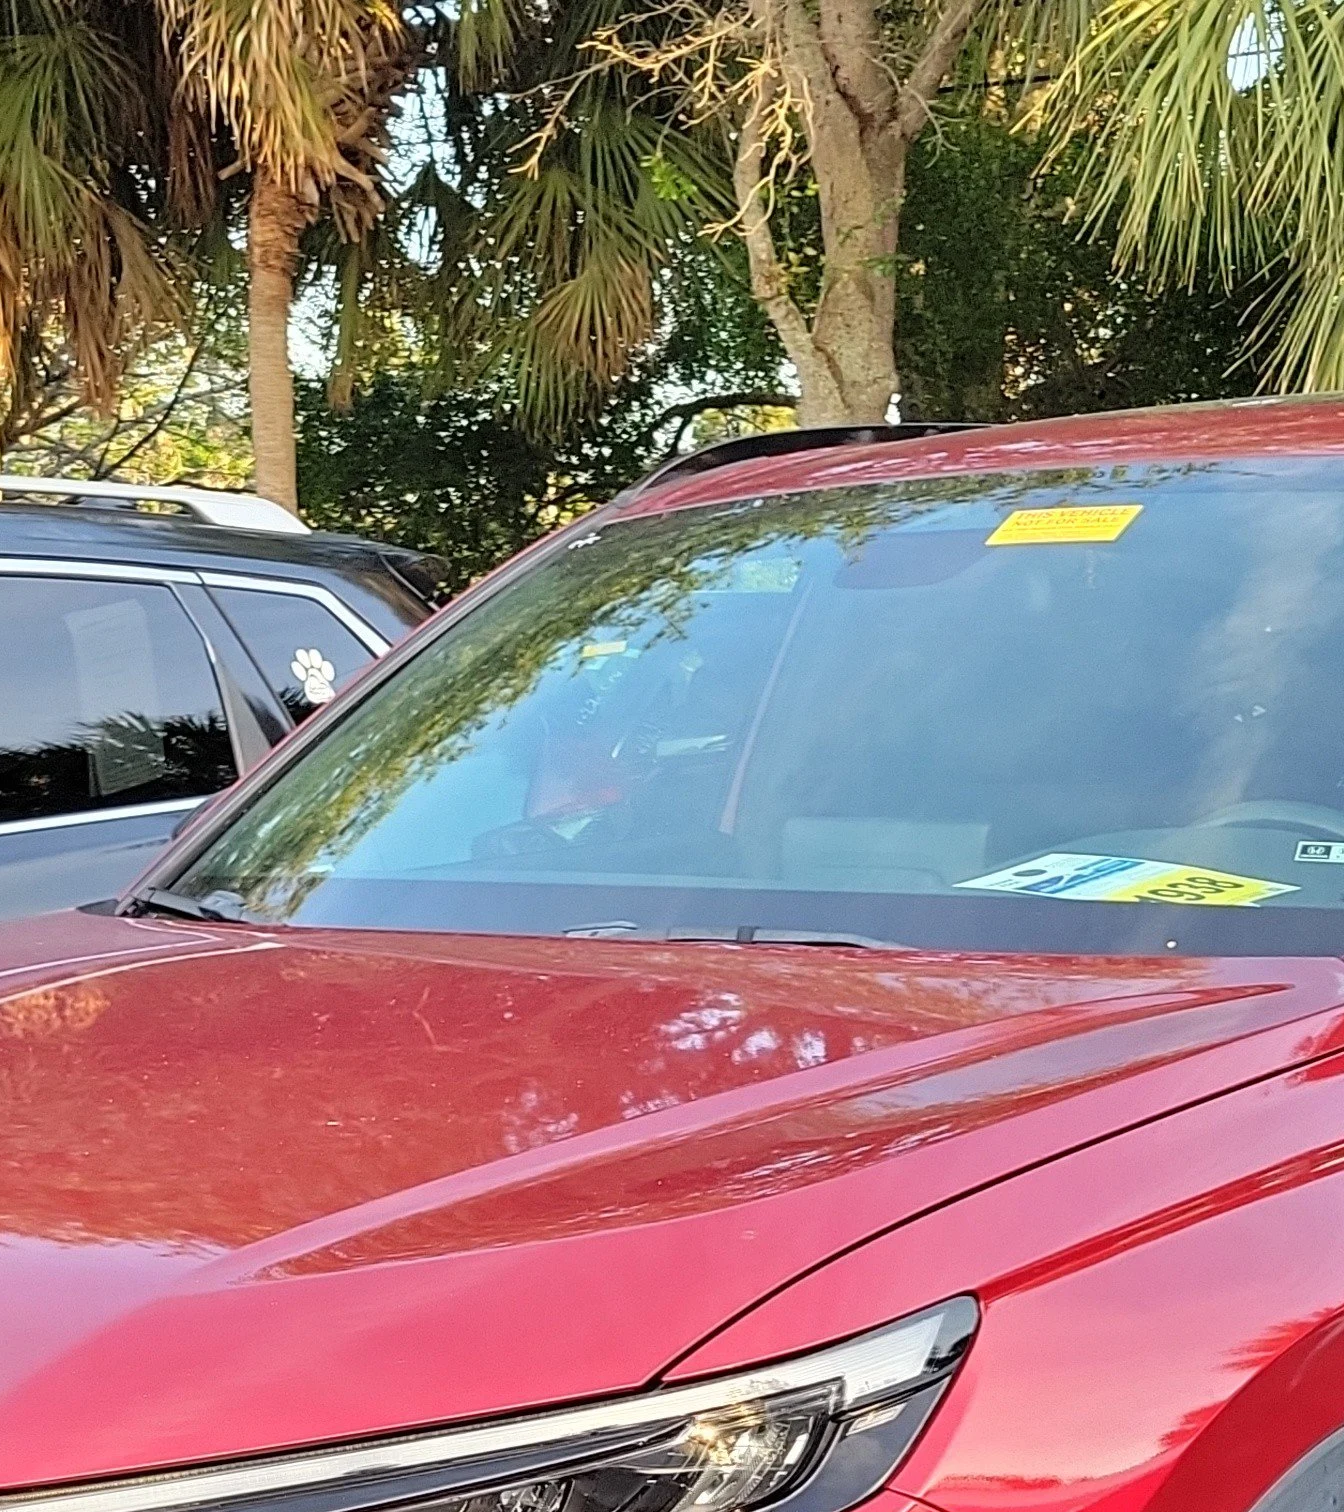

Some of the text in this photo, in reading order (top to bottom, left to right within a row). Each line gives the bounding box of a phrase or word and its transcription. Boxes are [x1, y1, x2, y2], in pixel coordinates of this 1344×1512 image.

[1016, 508, 1131, 520] THIS VEHICLE
[1012, 519, 1041, 527] NOT
[1081, 516, 1121, 524] SALE
